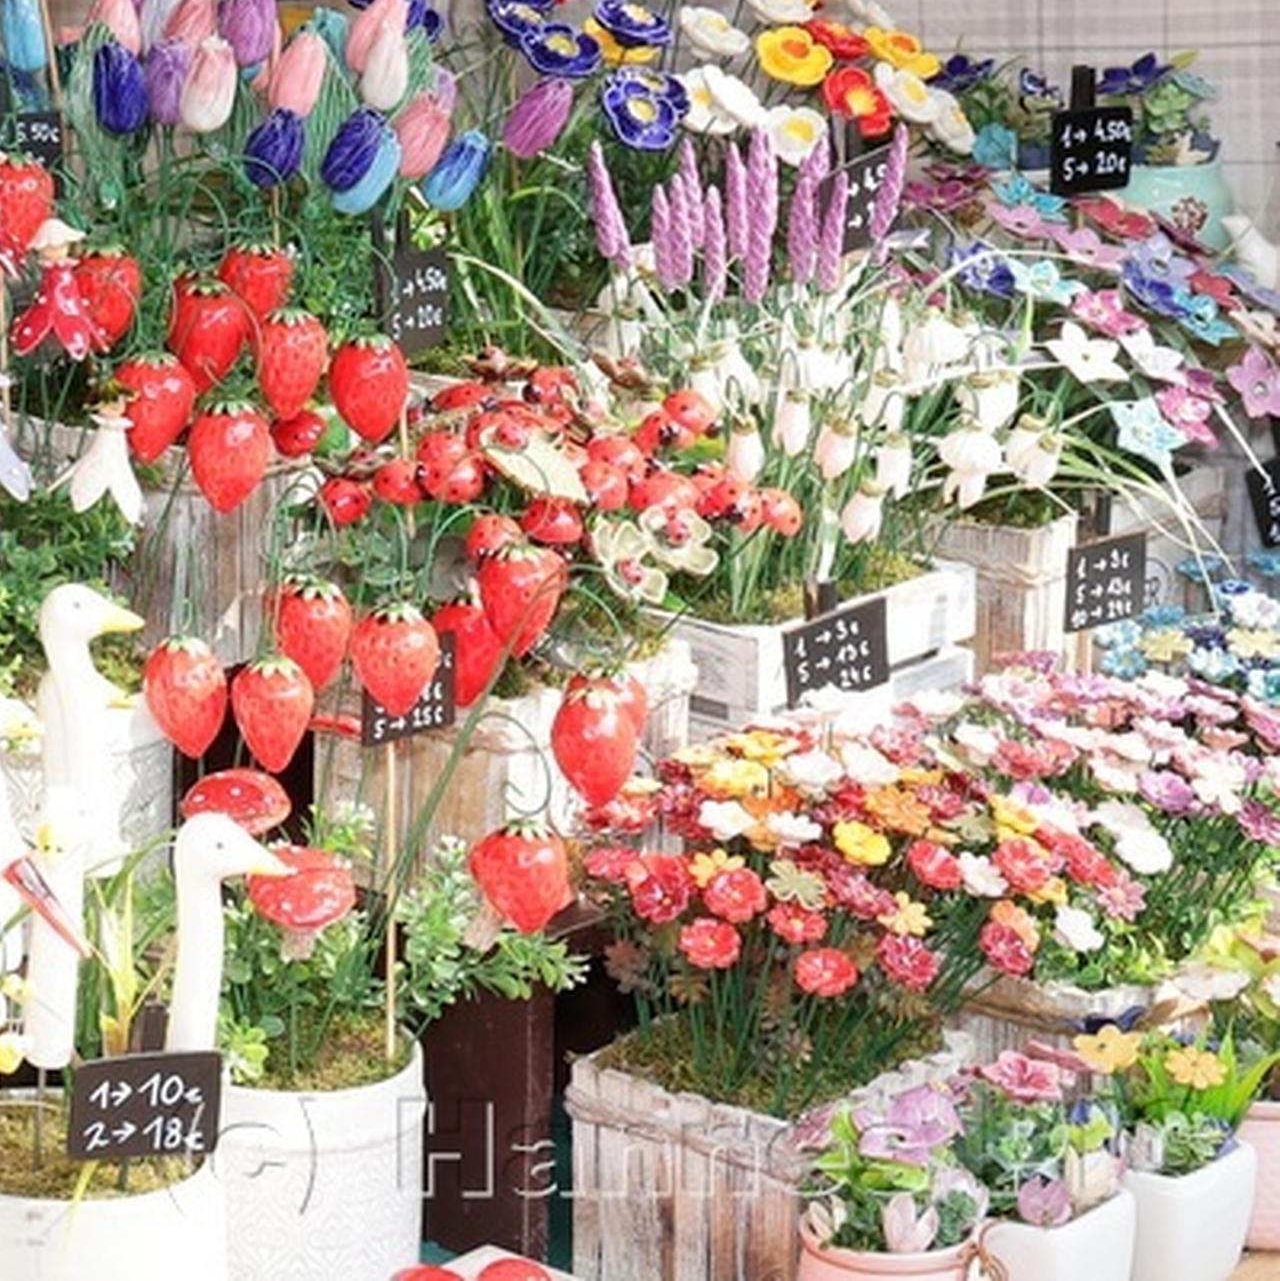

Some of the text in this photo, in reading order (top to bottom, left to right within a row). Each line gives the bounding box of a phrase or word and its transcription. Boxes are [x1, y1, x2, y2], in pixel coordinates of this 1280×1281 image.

[1060, 124, 1071, 149] 1
[1063, 150, 1126, 182] 5 20€
[89, 1072, 204, 1108] 1 10€
[83, 1115, 204, 1151] 2 18€
